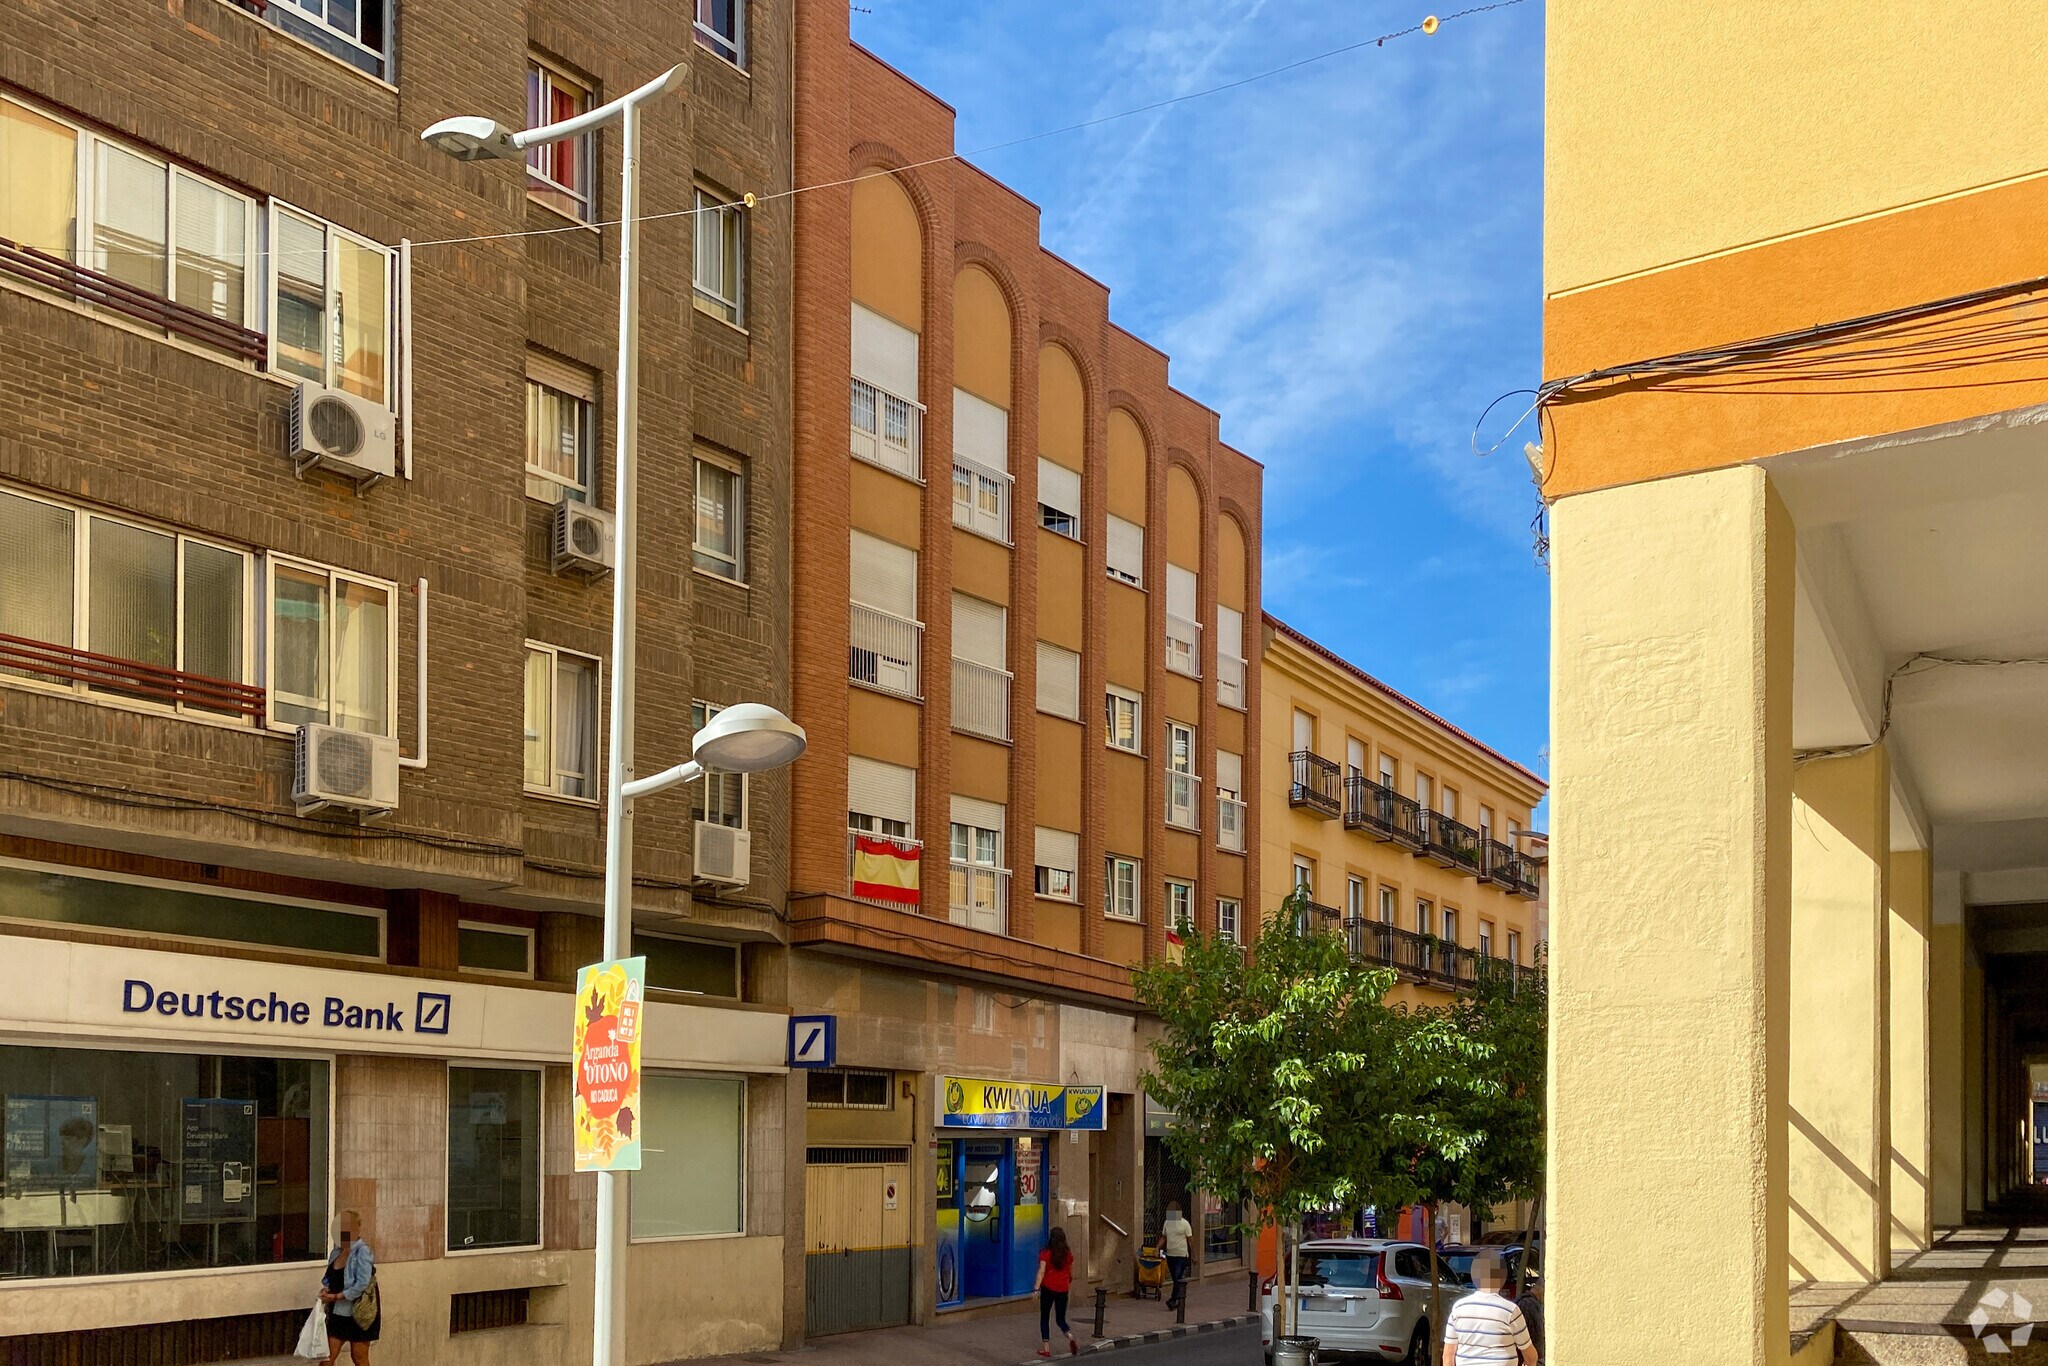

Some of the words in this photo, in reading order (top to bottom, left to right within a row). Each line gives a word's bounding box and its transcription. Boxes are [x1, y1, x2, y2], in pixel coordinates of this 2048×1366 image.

[123, 979, 310, 1025] Deutsche
[323, 997, 404, 1032] Bank
[584, 1043, 619, 1065] Arganda
[586, 1058, 628, 1085] OTOÑO
[1022, 1174, 1036, 1194] 30
